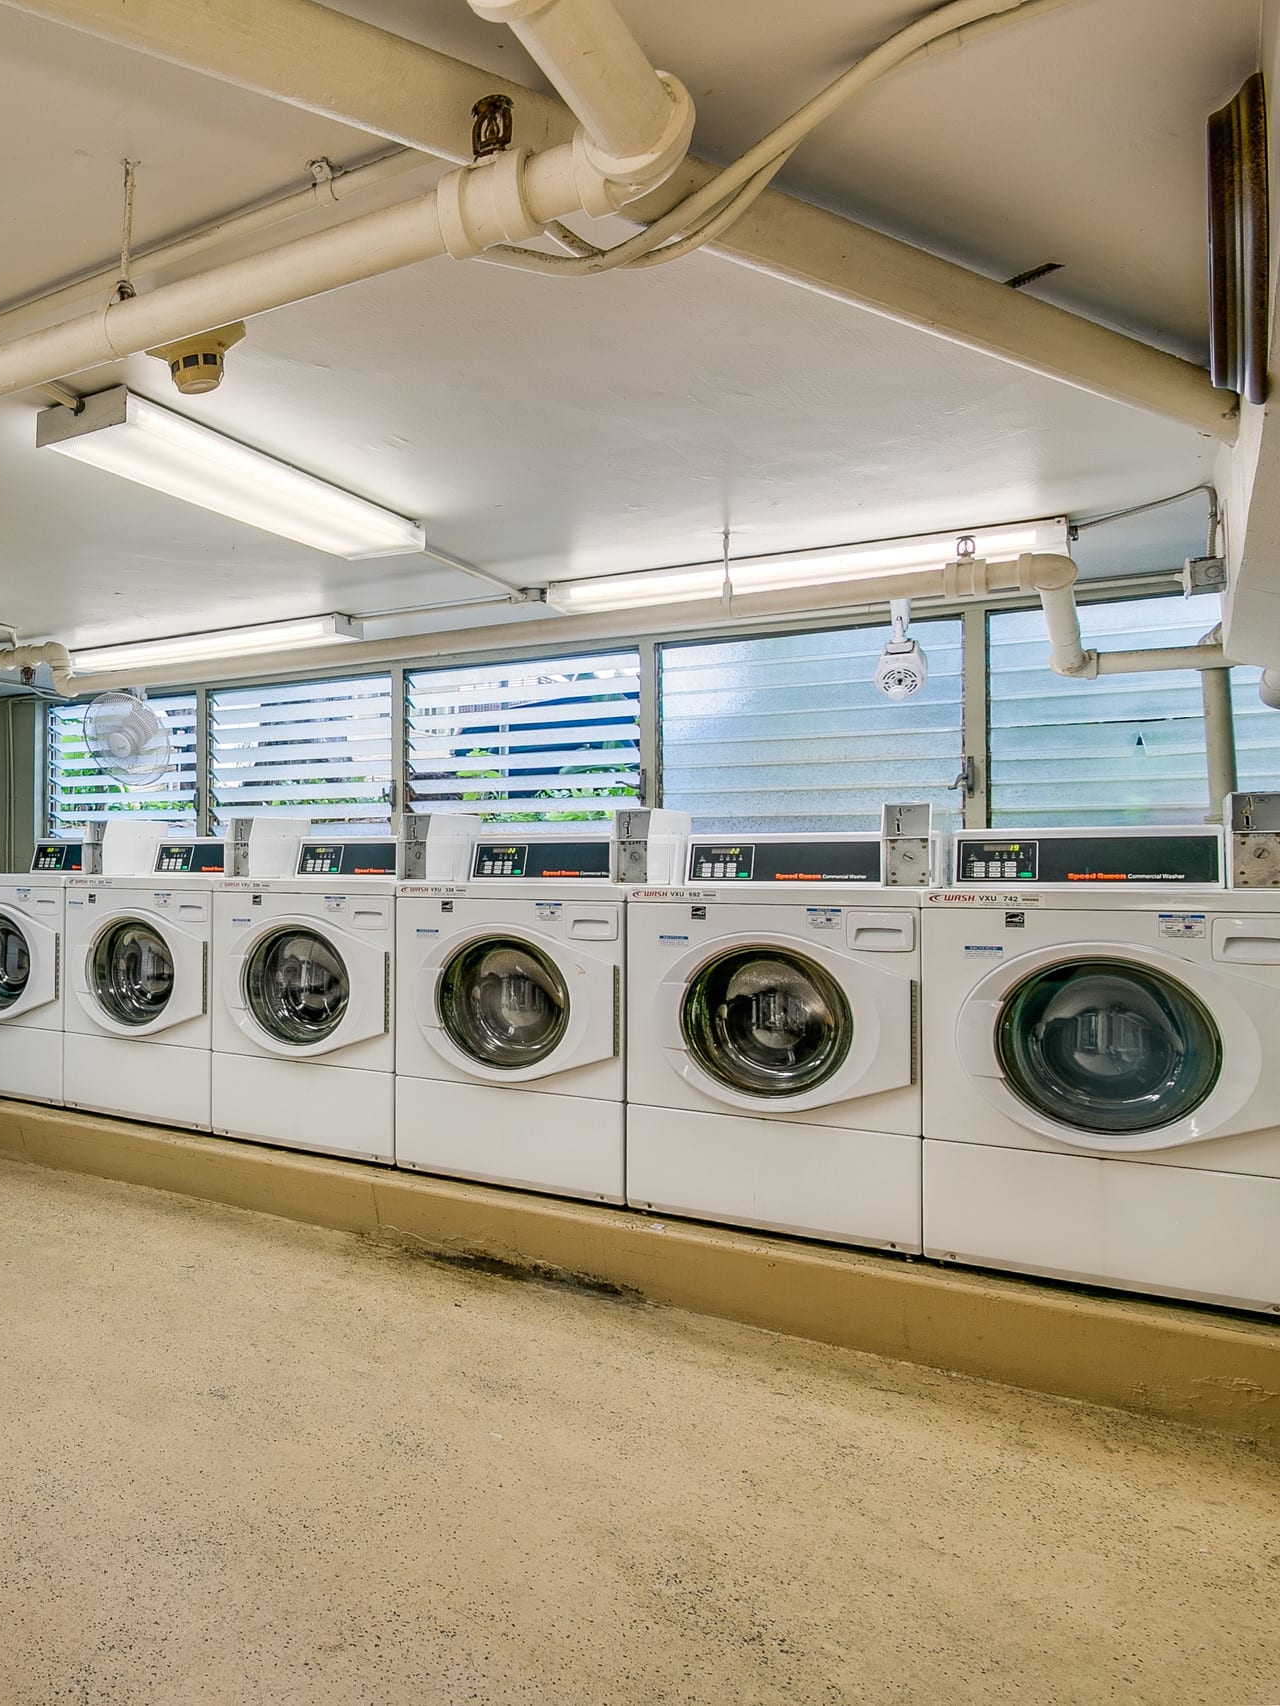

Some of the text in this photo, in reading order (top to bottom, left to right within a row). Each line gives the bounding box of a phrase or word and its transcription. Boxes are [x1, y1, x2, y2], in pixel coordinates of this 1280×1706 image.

[1067, 872, 1097, 880] Speed
[1097, 872, 1127, 880] Queen
[944, 894, 976, 902] WASH
